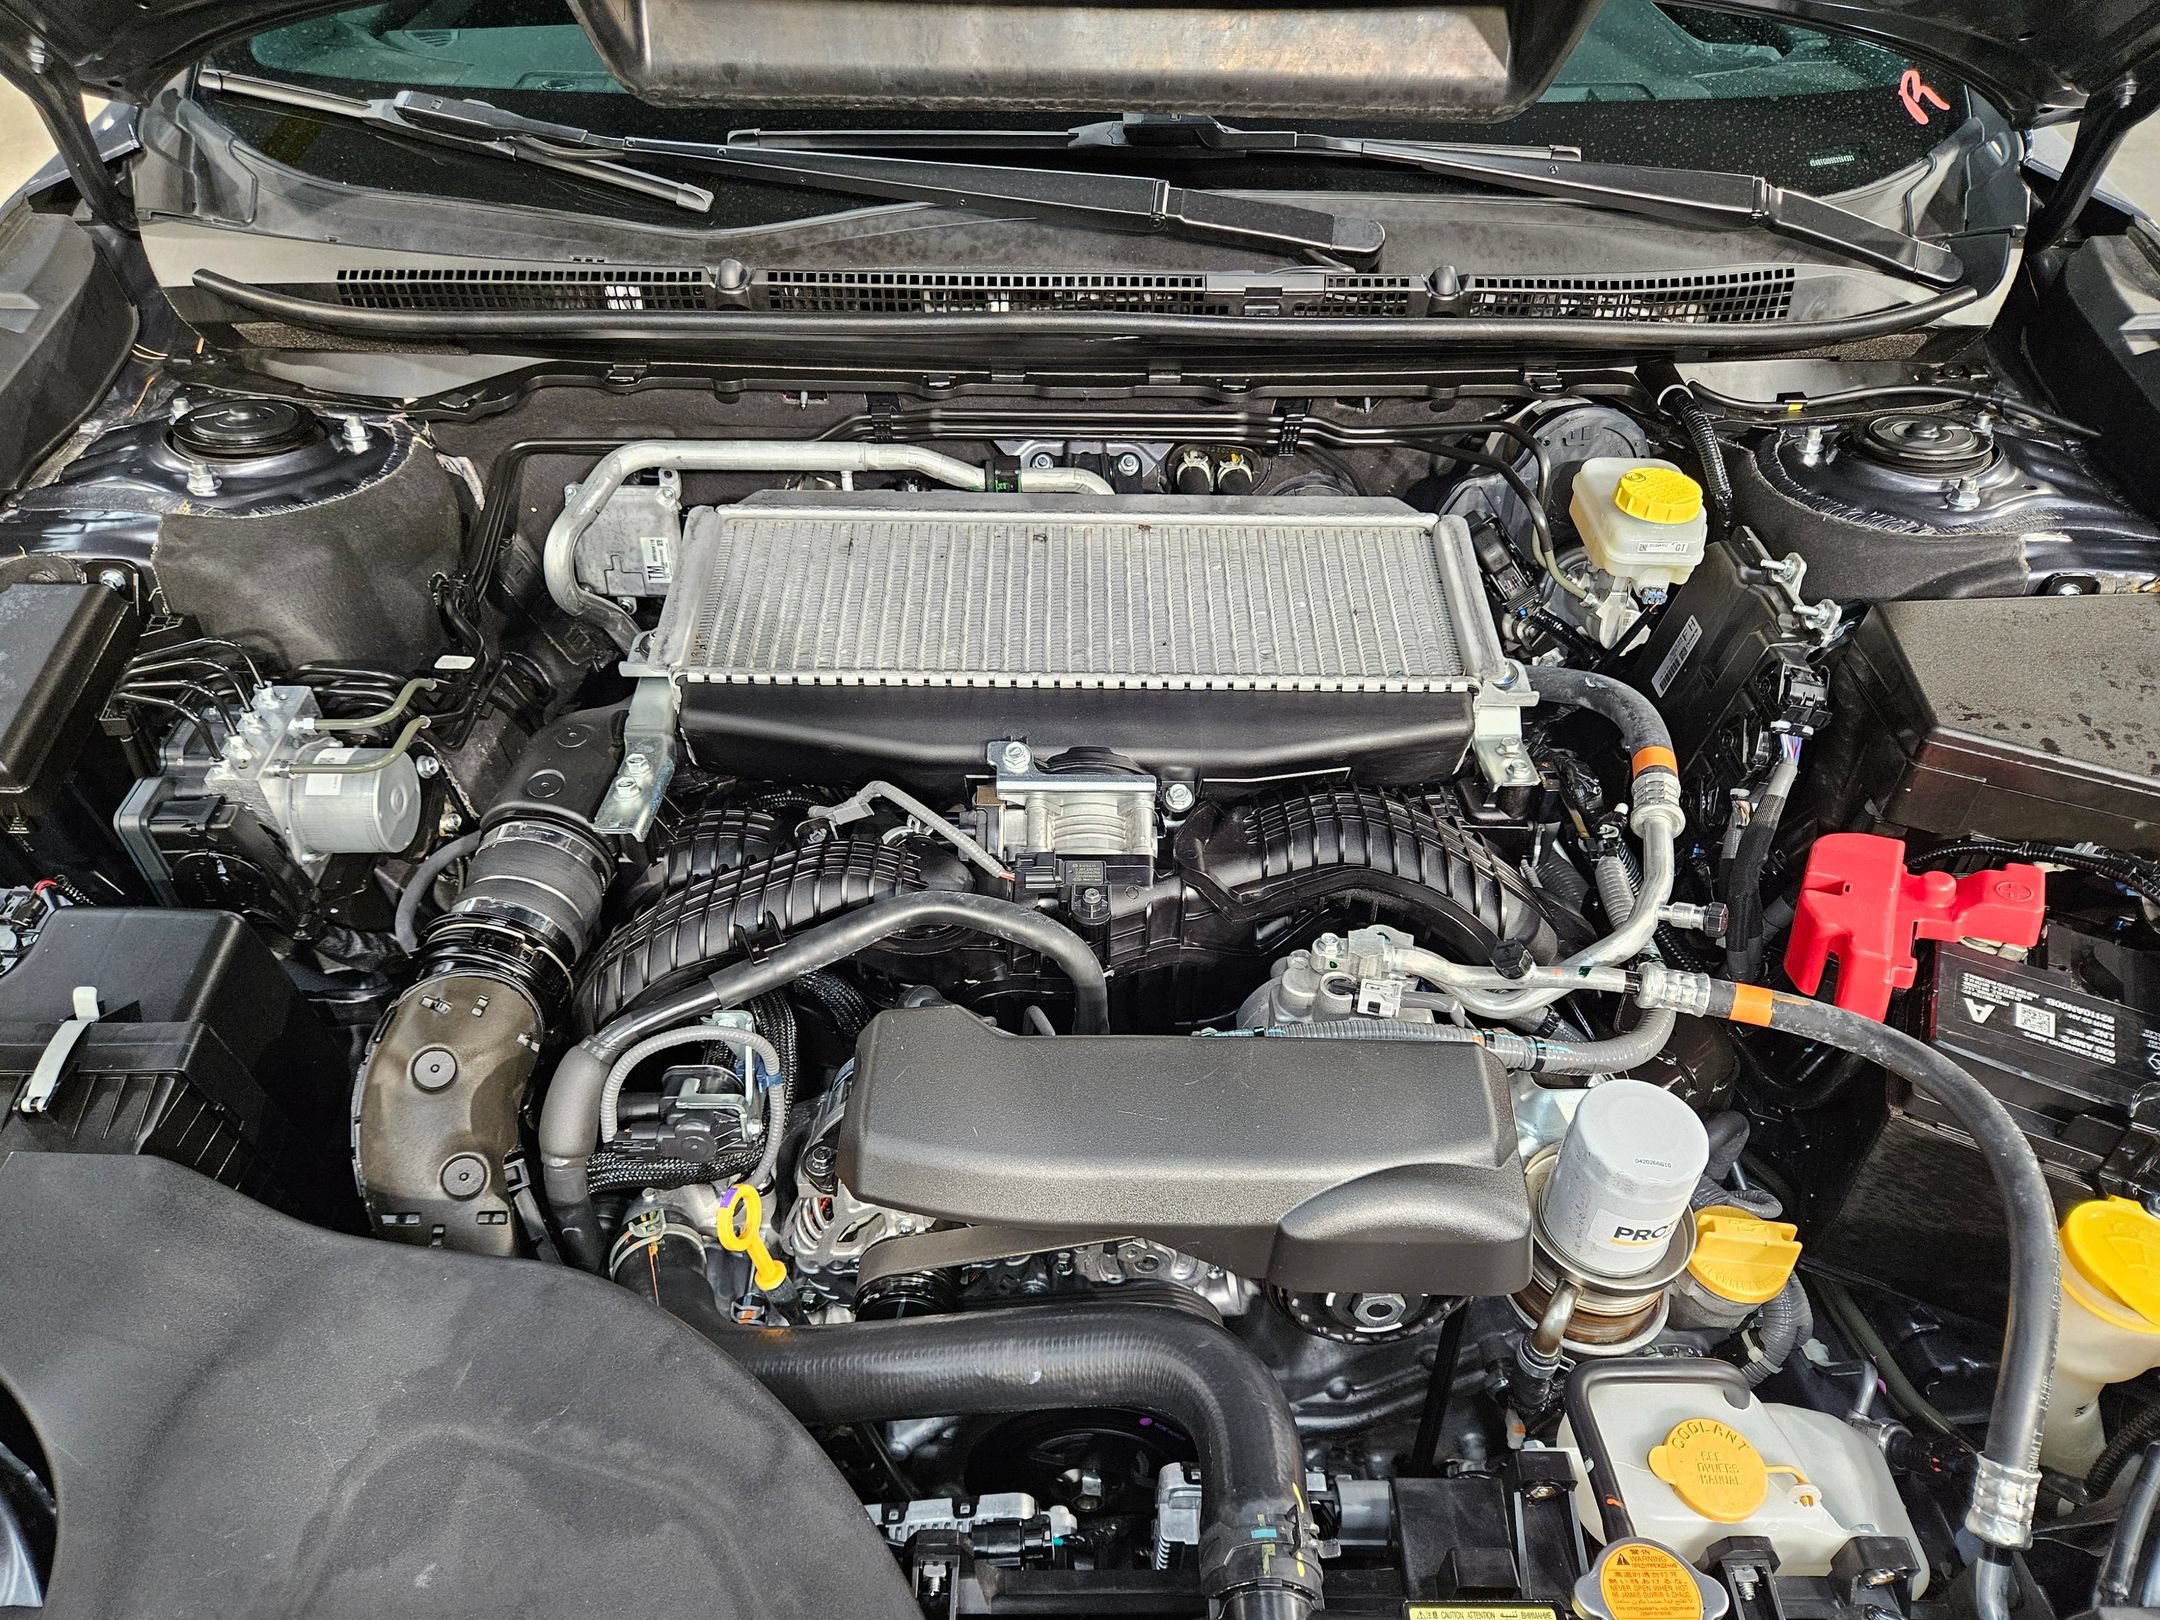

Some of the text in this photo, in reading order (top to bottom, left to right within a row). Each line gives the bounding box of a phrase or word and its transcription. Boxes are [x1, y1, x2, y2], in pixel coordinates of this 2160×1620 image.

[1898, 70, 1950, 125] R
[2061, 1034, 2092, 1051] AMPS
[2093, 1052, 2115, 1064] COLD
[1672, 1422, 1750, 1450] COOLANT
[1700, 1451, 1721, 1461] SEE
